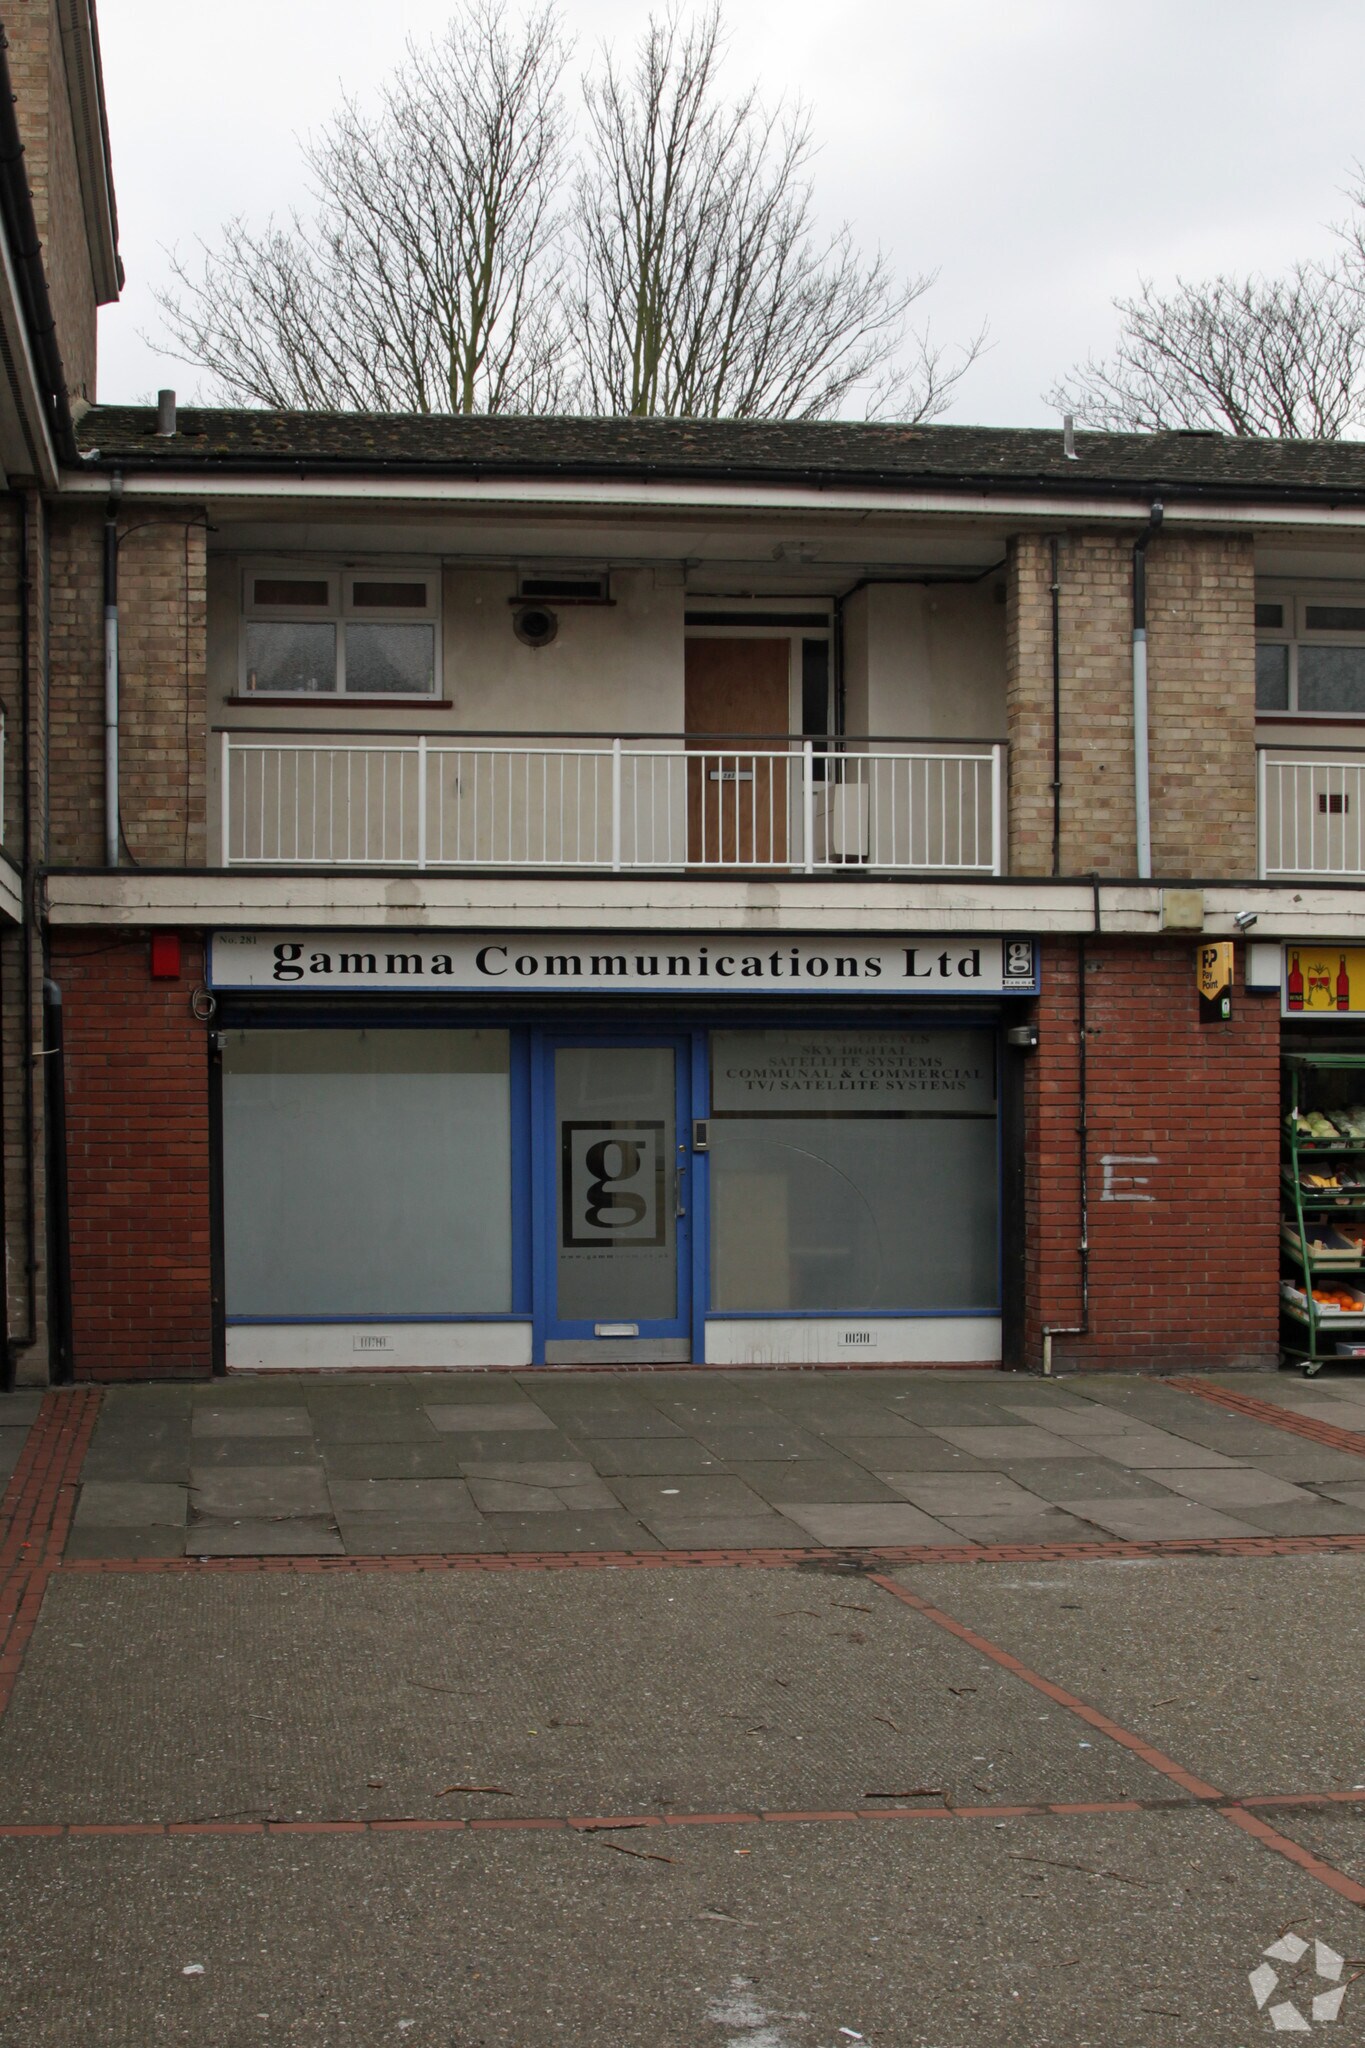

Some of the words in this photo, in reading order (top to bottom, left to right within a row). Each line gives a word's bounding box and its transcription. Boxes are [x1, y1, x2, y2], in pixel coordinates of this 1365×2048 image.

[239, 936, 257, 945] 281
[272, 943, 454, 981] gamma
[475, 946, 883, 978] Communications
[901, 948, 982, 978] Ltd
[1203, 971, 1213, 981] Pay
[1202, 980, 1219, 990] Point
[801, 1046, 832, 1055] SKY
[842, 1046, 911, 1055] DIGITAL
[769, 1057, 861, 1067] SATELLITE
[867, 1057, 943, 1067] SYSTEMS
[726, 1069, 834, 1078] COMMUNAL
[840, 1069, 852, 1078] &
[859, 1069, 984, 1079] COMMERCIAL
[744, 1080, 774, 1091] TV/
[780, 1080, 880, 1090] SATELLITE
[886, 1080, 967, 1090] SYSTEMS
[585, 1140, 647, 1228] g
